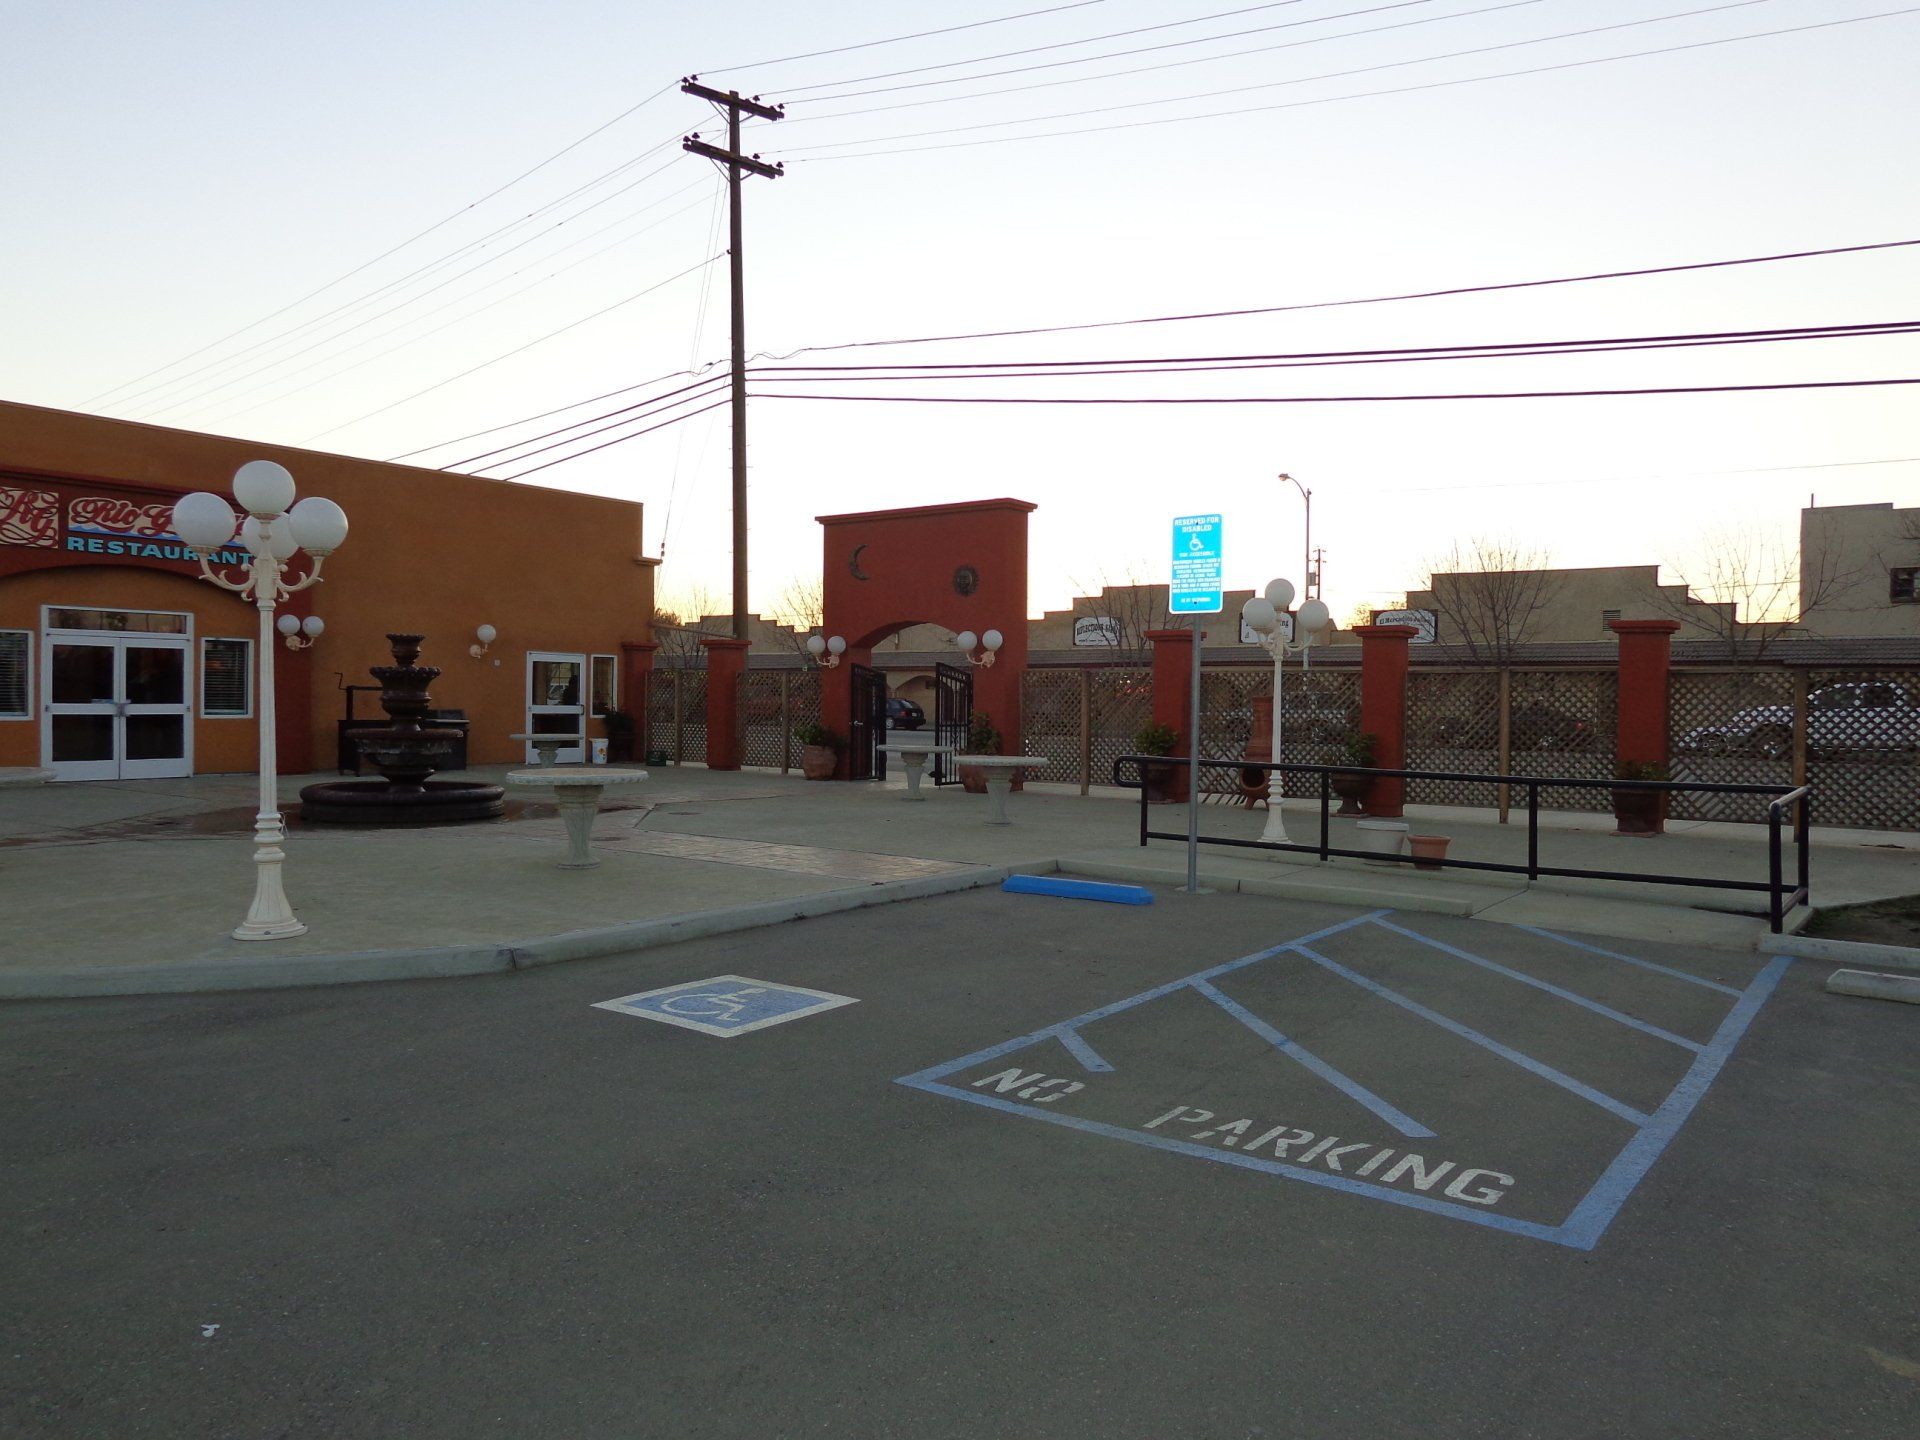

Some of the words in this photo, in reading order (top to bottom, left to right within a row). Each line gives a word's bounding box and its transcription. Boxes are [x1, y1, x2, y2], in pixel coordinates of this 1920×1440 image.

[71, 500, 141, 533] Rio
[1174, 517, 1206, 527] RESERVED
[1207, 516, 1220, 524] FOR
[1182, 524, 1212, 533] DISABLED
[971, 1067, 1086, 1103] NO
[1142, 1105, 1516, 1206] PARKING
